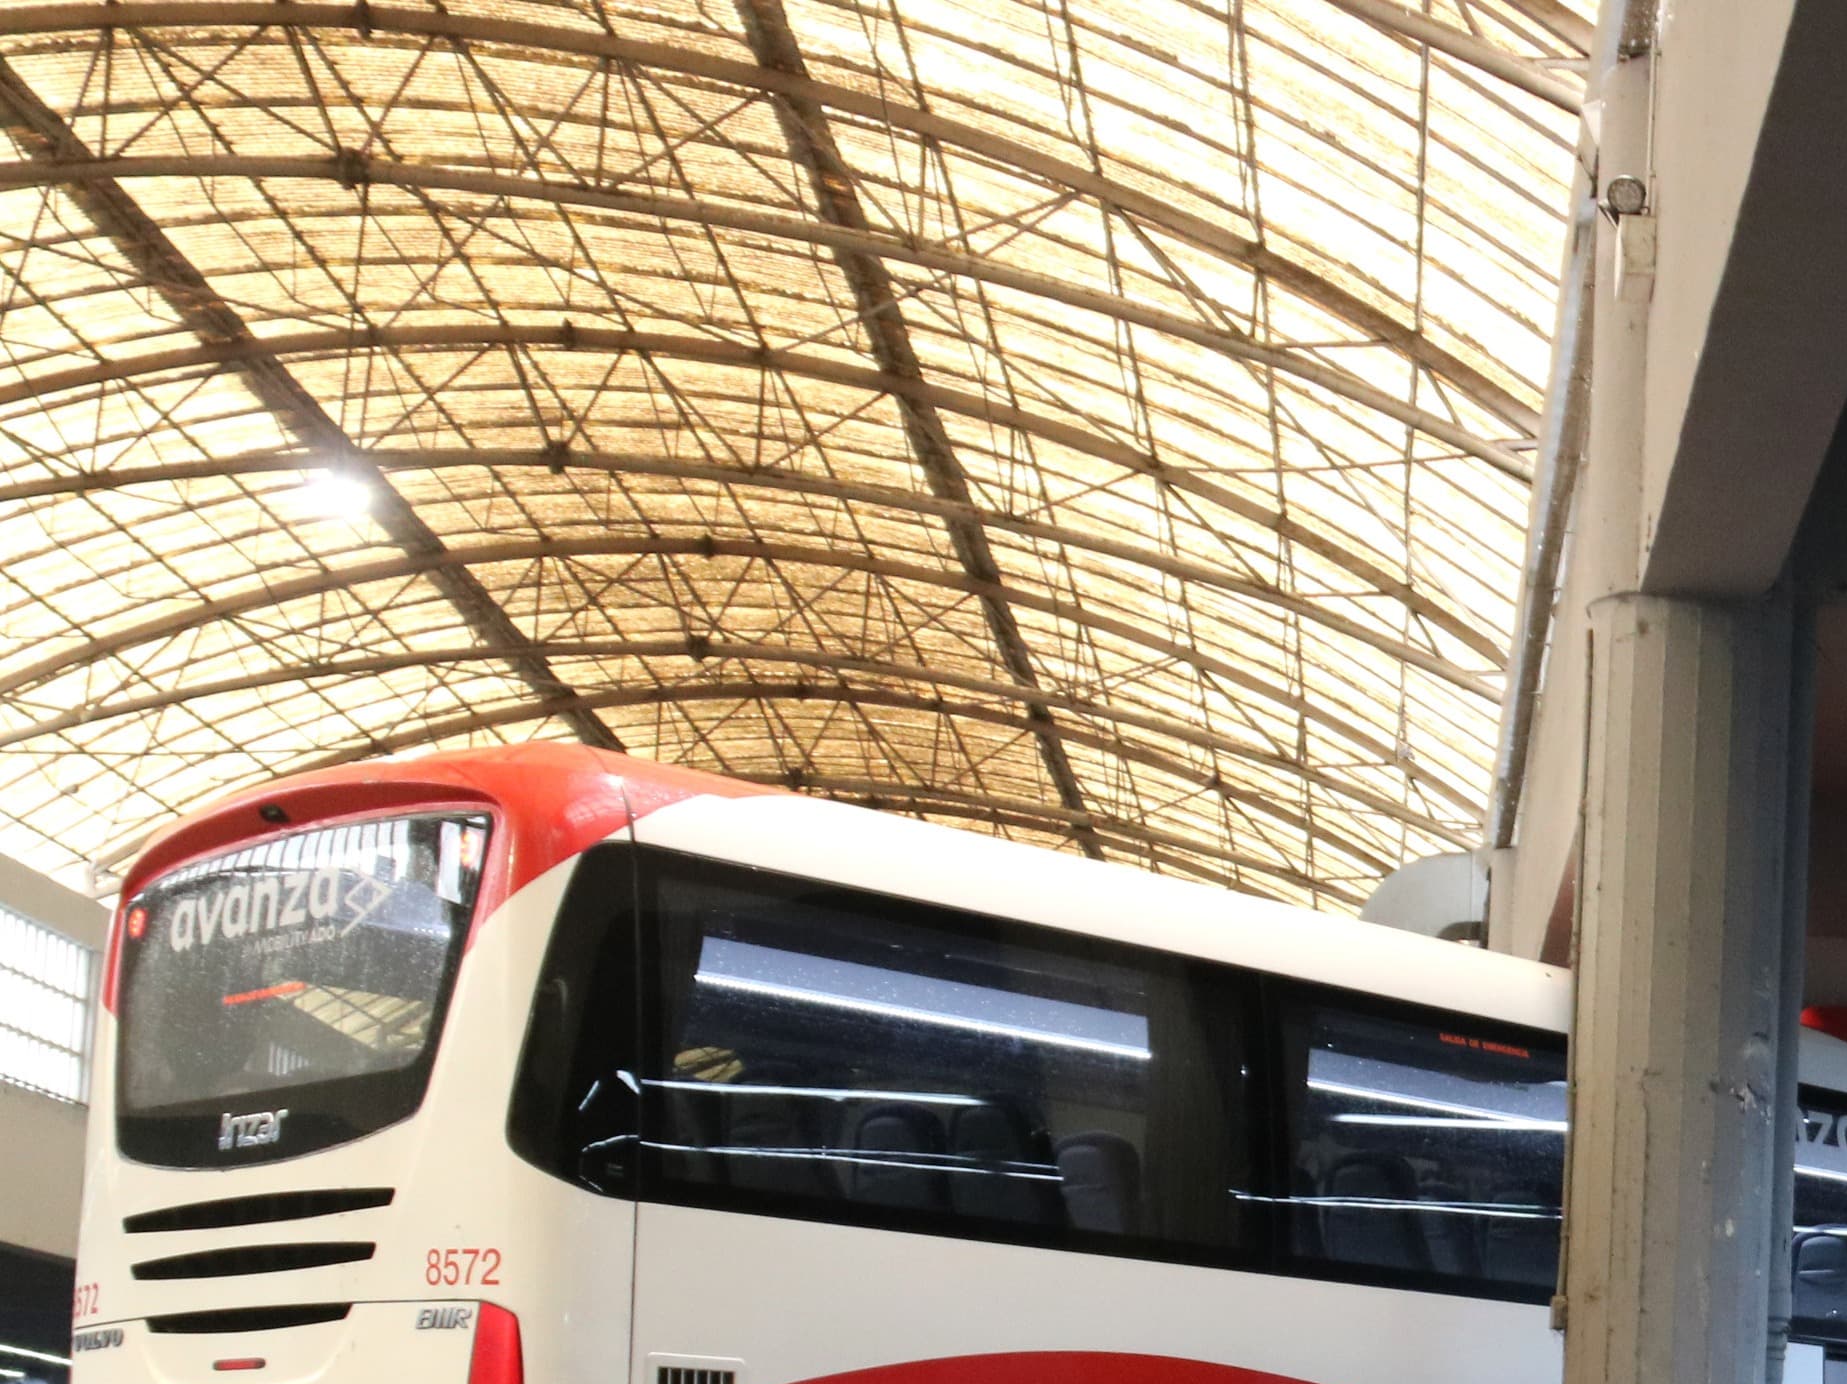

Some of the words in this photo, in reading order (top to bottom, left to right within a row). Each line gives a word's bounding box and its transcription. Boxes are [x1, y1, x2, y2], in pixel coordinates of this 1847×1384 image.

[170, 867, 340, 952] avanza
[426, 1248, 502, 1286] 8572
[73, 1283, 99, 1317] 572
